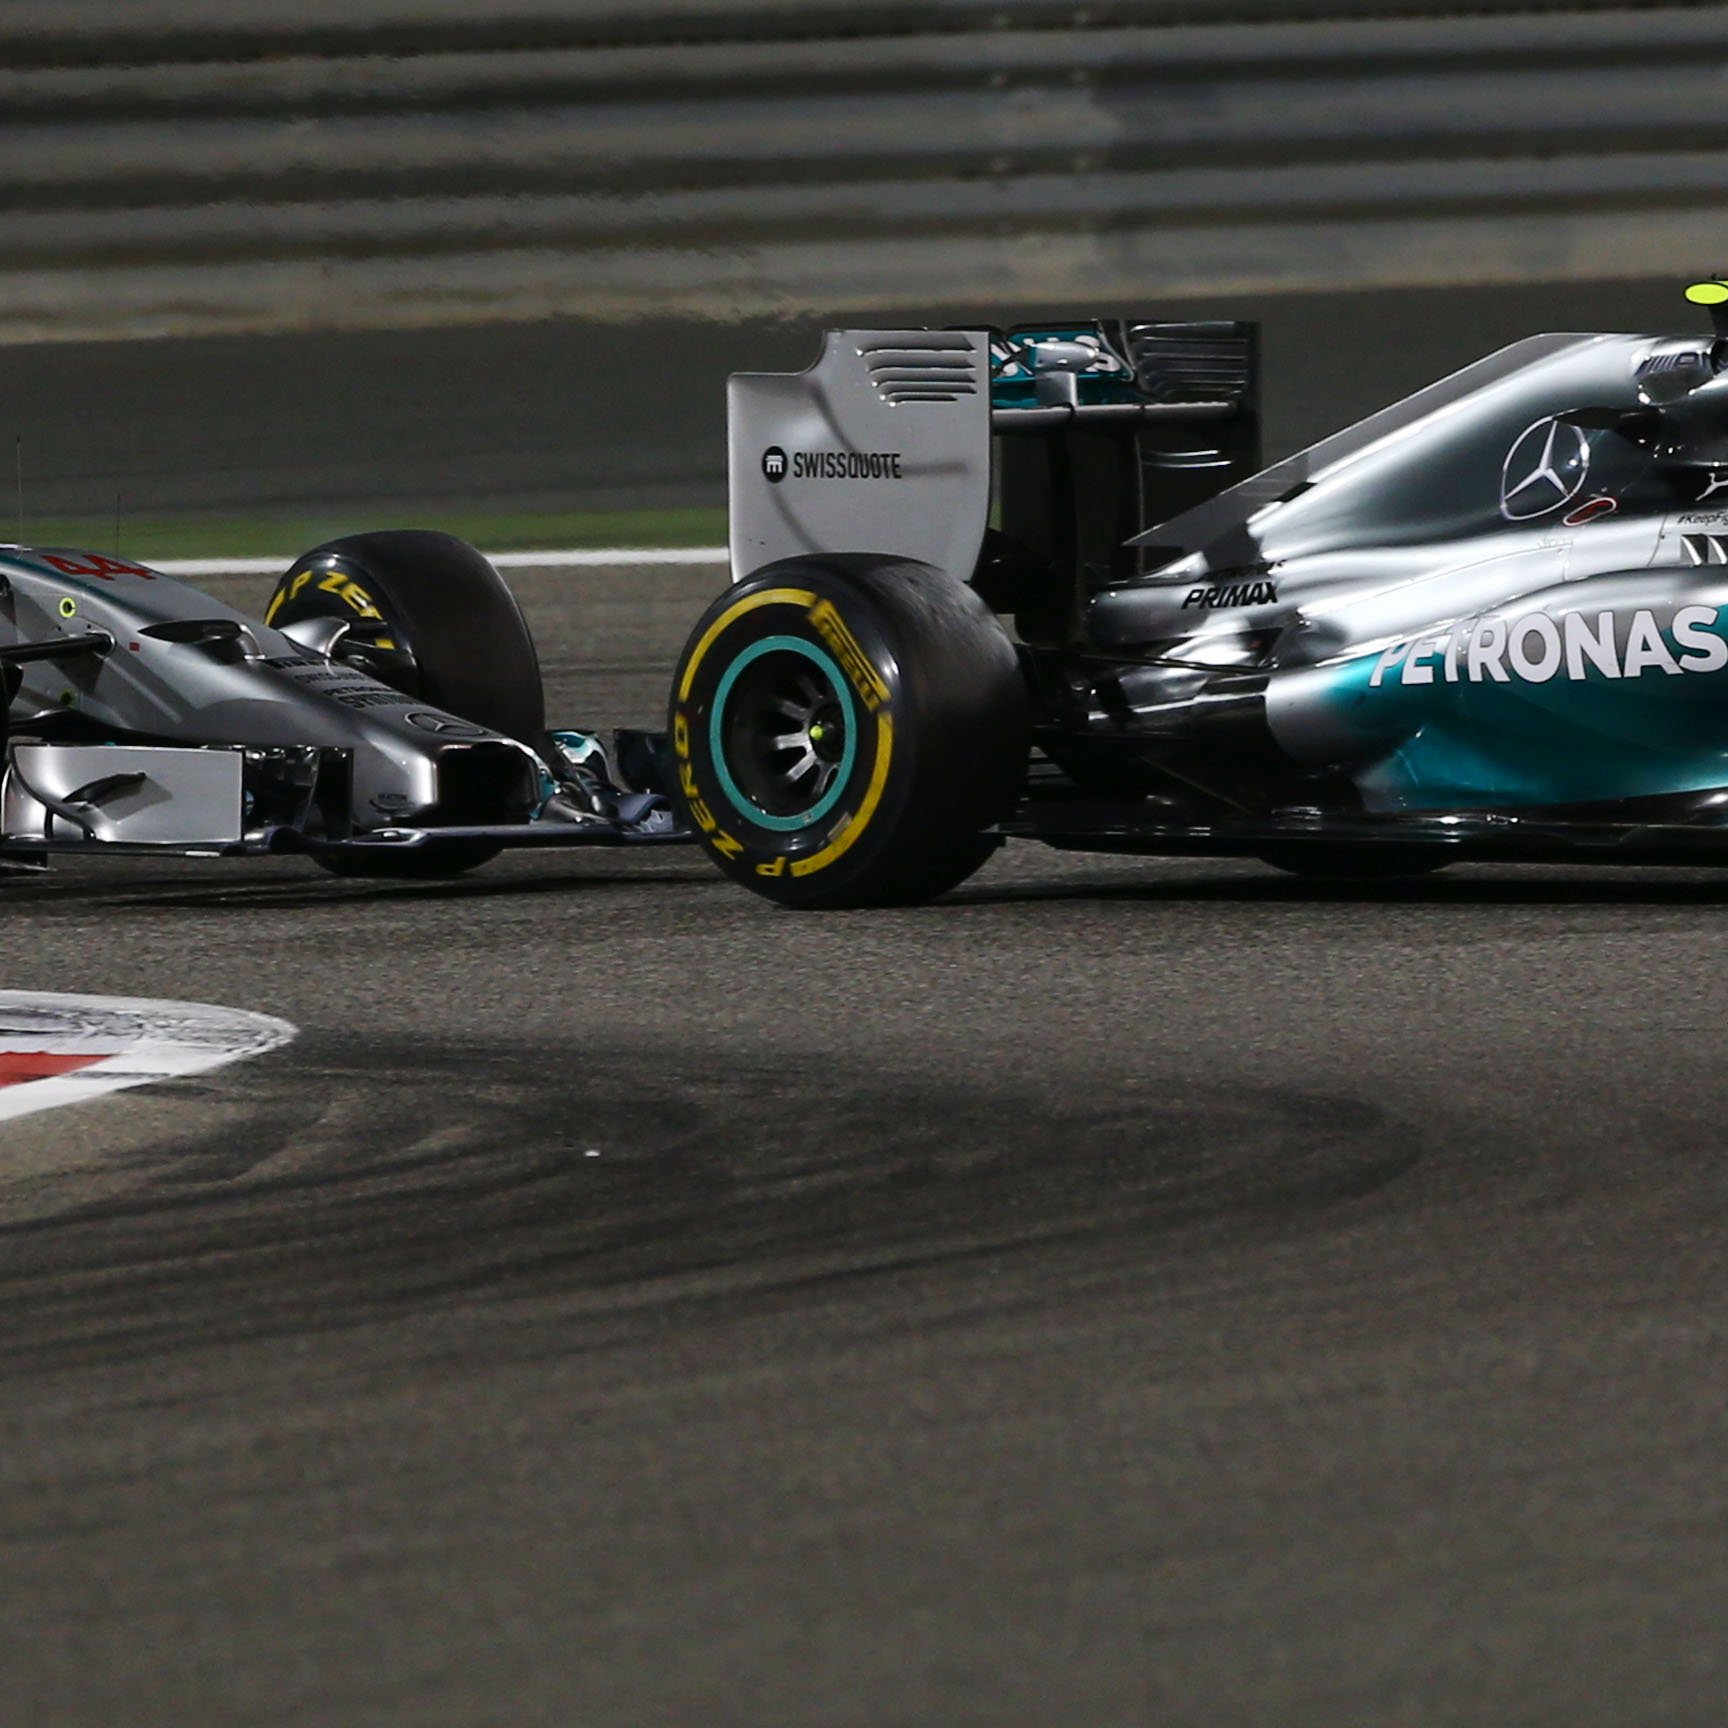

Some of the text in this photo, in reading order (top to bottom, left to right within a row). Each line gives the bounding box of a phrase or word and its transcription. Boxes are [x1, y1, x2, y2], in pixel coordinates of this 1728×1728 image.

[793, 452, 903, 479] SWISSQUOTE
[40, 554, 157, 581] 44
[289, 570, 313, 601] P
[1180, 581, 1279, 610] PRIMAX
[674, 713, 786, 877] P ZERO
